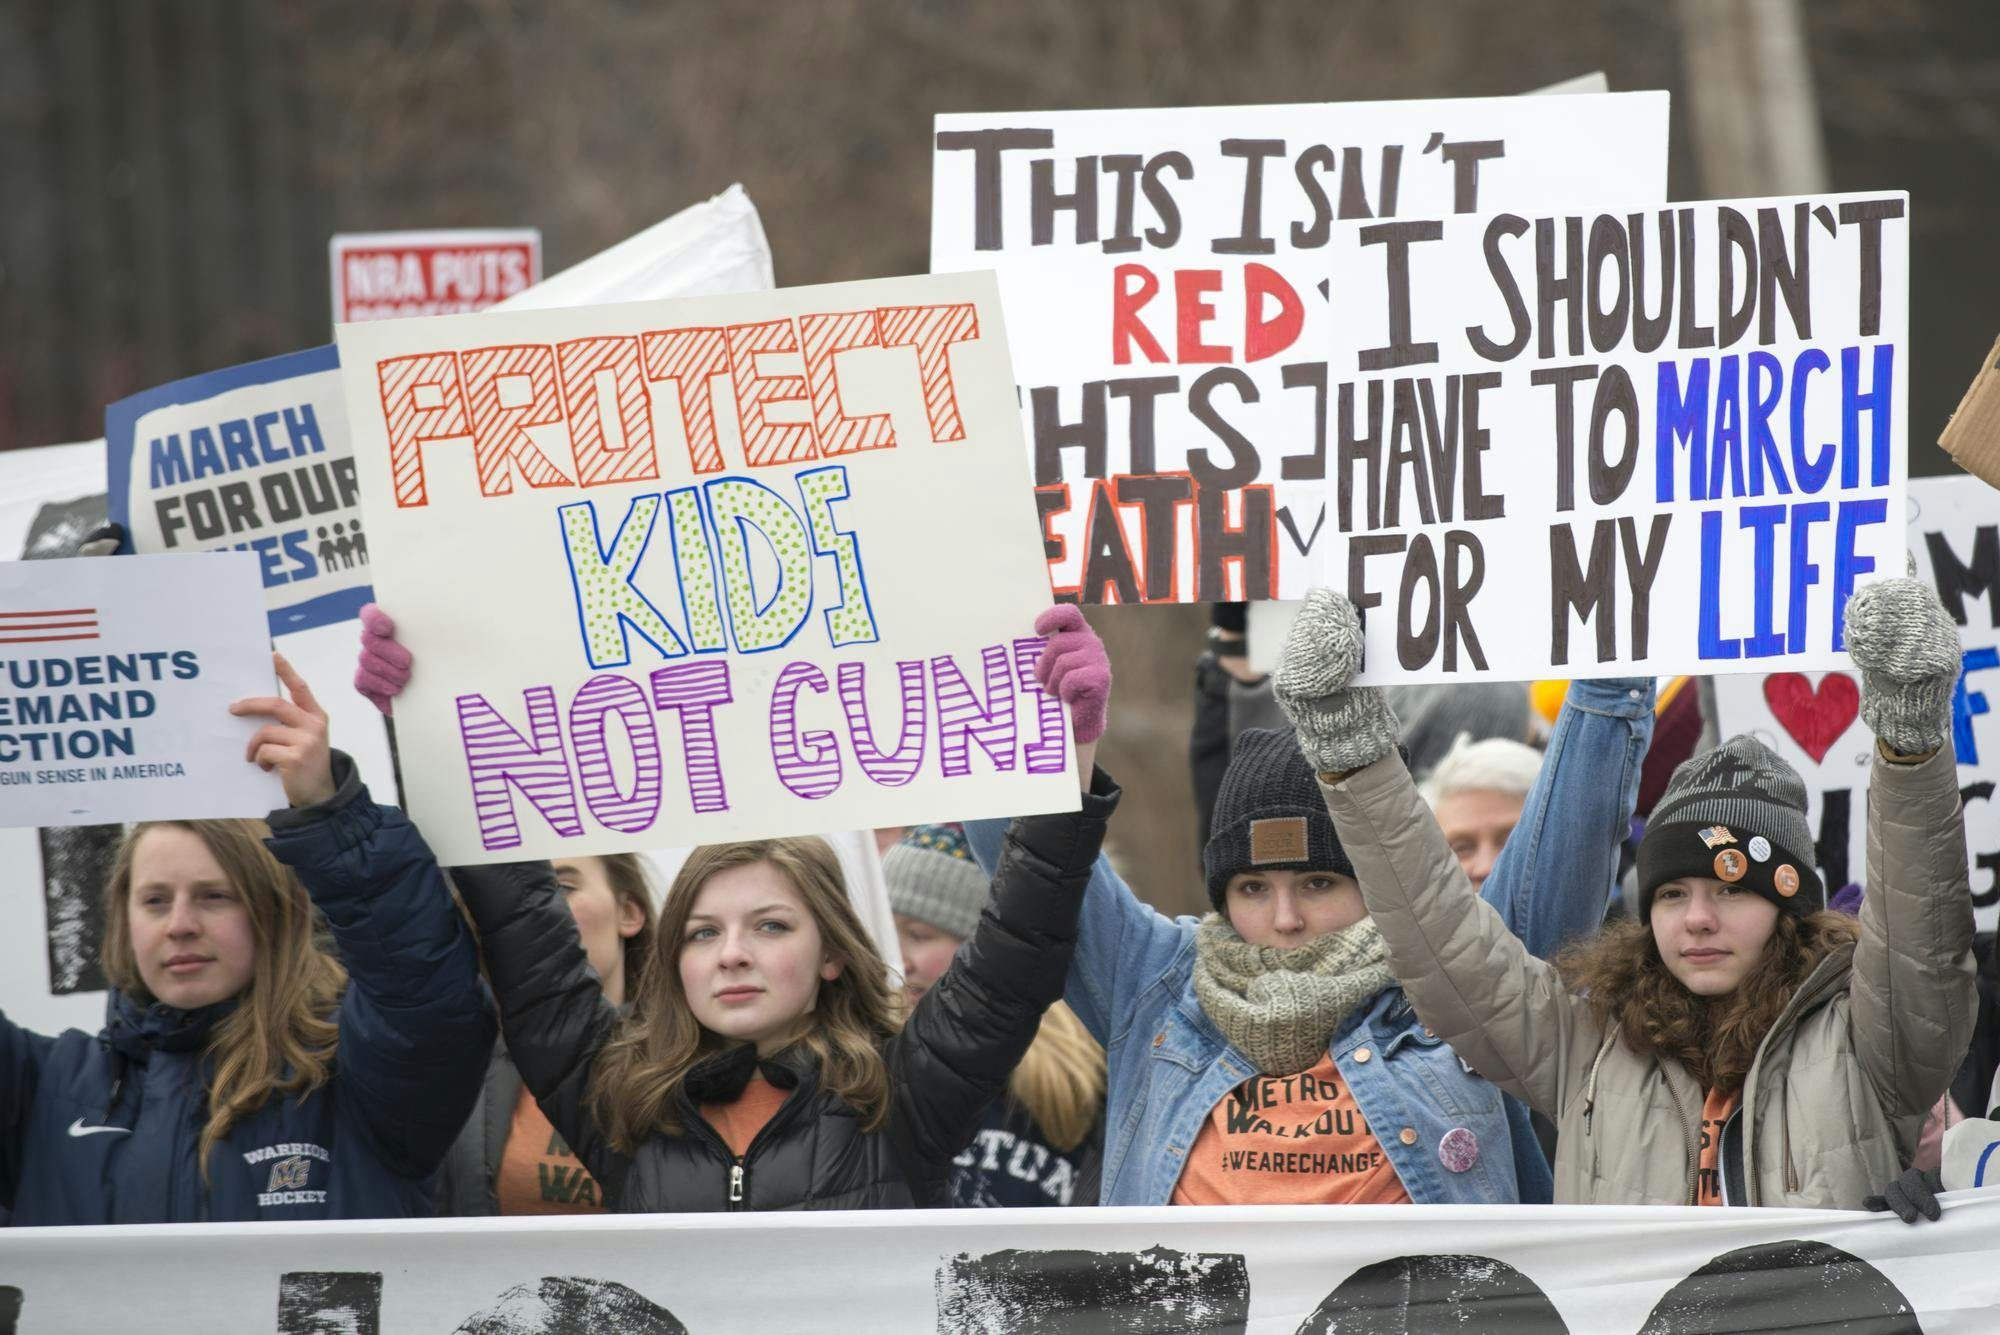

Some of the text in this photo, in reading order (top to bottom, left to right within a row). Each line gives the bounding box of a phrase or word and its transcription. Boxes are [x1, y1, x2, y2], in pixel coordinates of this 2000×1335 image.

[937, 128, 1195, 254] THIS
[346, 248, 530, 301] NRA PUTS
[1113, 262, 1305, 365] RED
[1357, 198, 1905, 372] I SHOULDN'T
[150, 403, 326, 490] MARCH
[377, 303, 981, 508] PROTECT
[1016, 366, 1262, 492] HTS
[1337, 344, 1894, 533] HAVE TO MARCH
[154, 456, 361, 548] FOR OUR
[557, 465, 880, 669] KIDS
[1348, 498, 1889, 673] FOR MY LIFE
[0, 762, 185, 786] GUN SENSE IN AMERICA
[456, 637, 1067, 851] NOT GUNS
[1232, 1072, 1340, 1112] METRO
[242, 1143, 331, 1165] WARRIOR
[256, 1190, 327, 1206] HOCKEY
